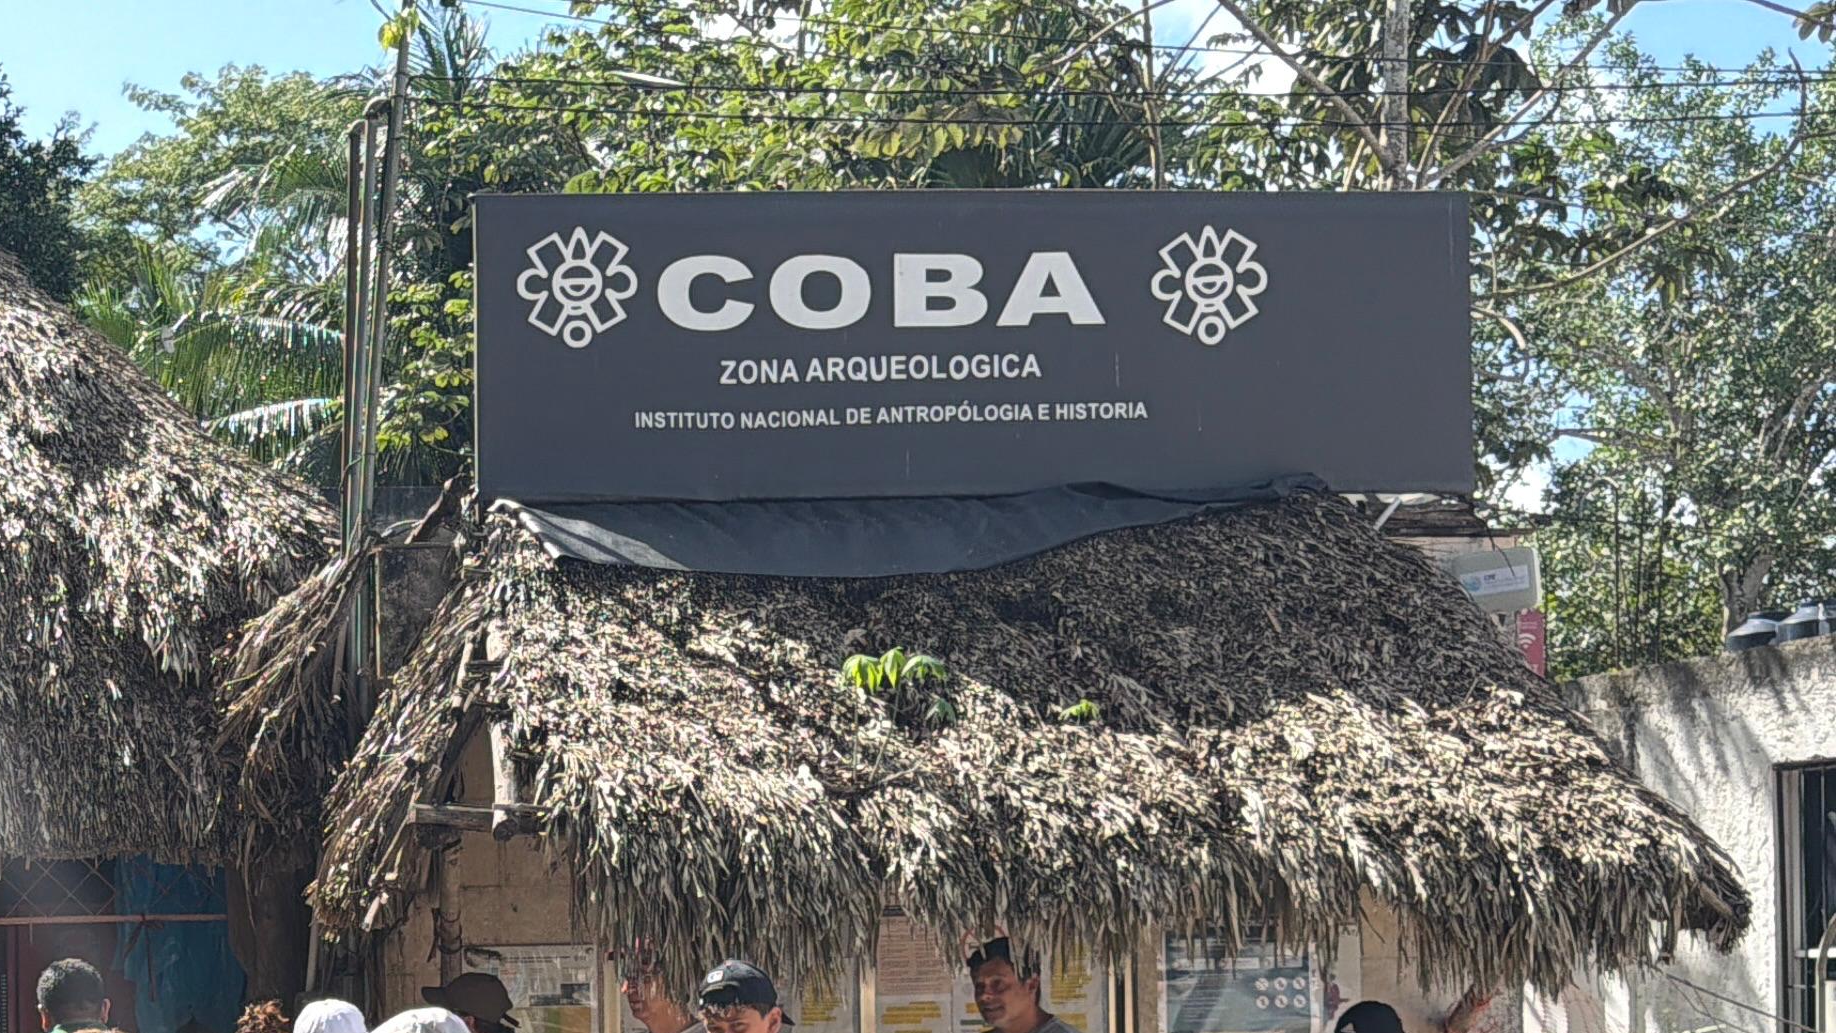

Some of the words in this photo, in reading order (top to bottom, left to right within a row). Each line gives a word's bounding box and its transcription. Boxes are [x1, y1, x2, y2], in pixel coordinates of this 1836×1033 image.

[657, 251, 1106, 331] COBA
[719, 358, 800, 385] ZONA
[805, 353, 1042, 383] ARQUEOLOGICA
[635, 411, 735, 430] INSTITUTO
[740, 408, 841, 429] NACIONAL
[846, 407, 872, 425] DE
[876, 399, 1034, 424] ANTROPÓLOGIA
[1037, 403, 1050, 421] E
[1055, 401, 1148, 420] HISTORIA
